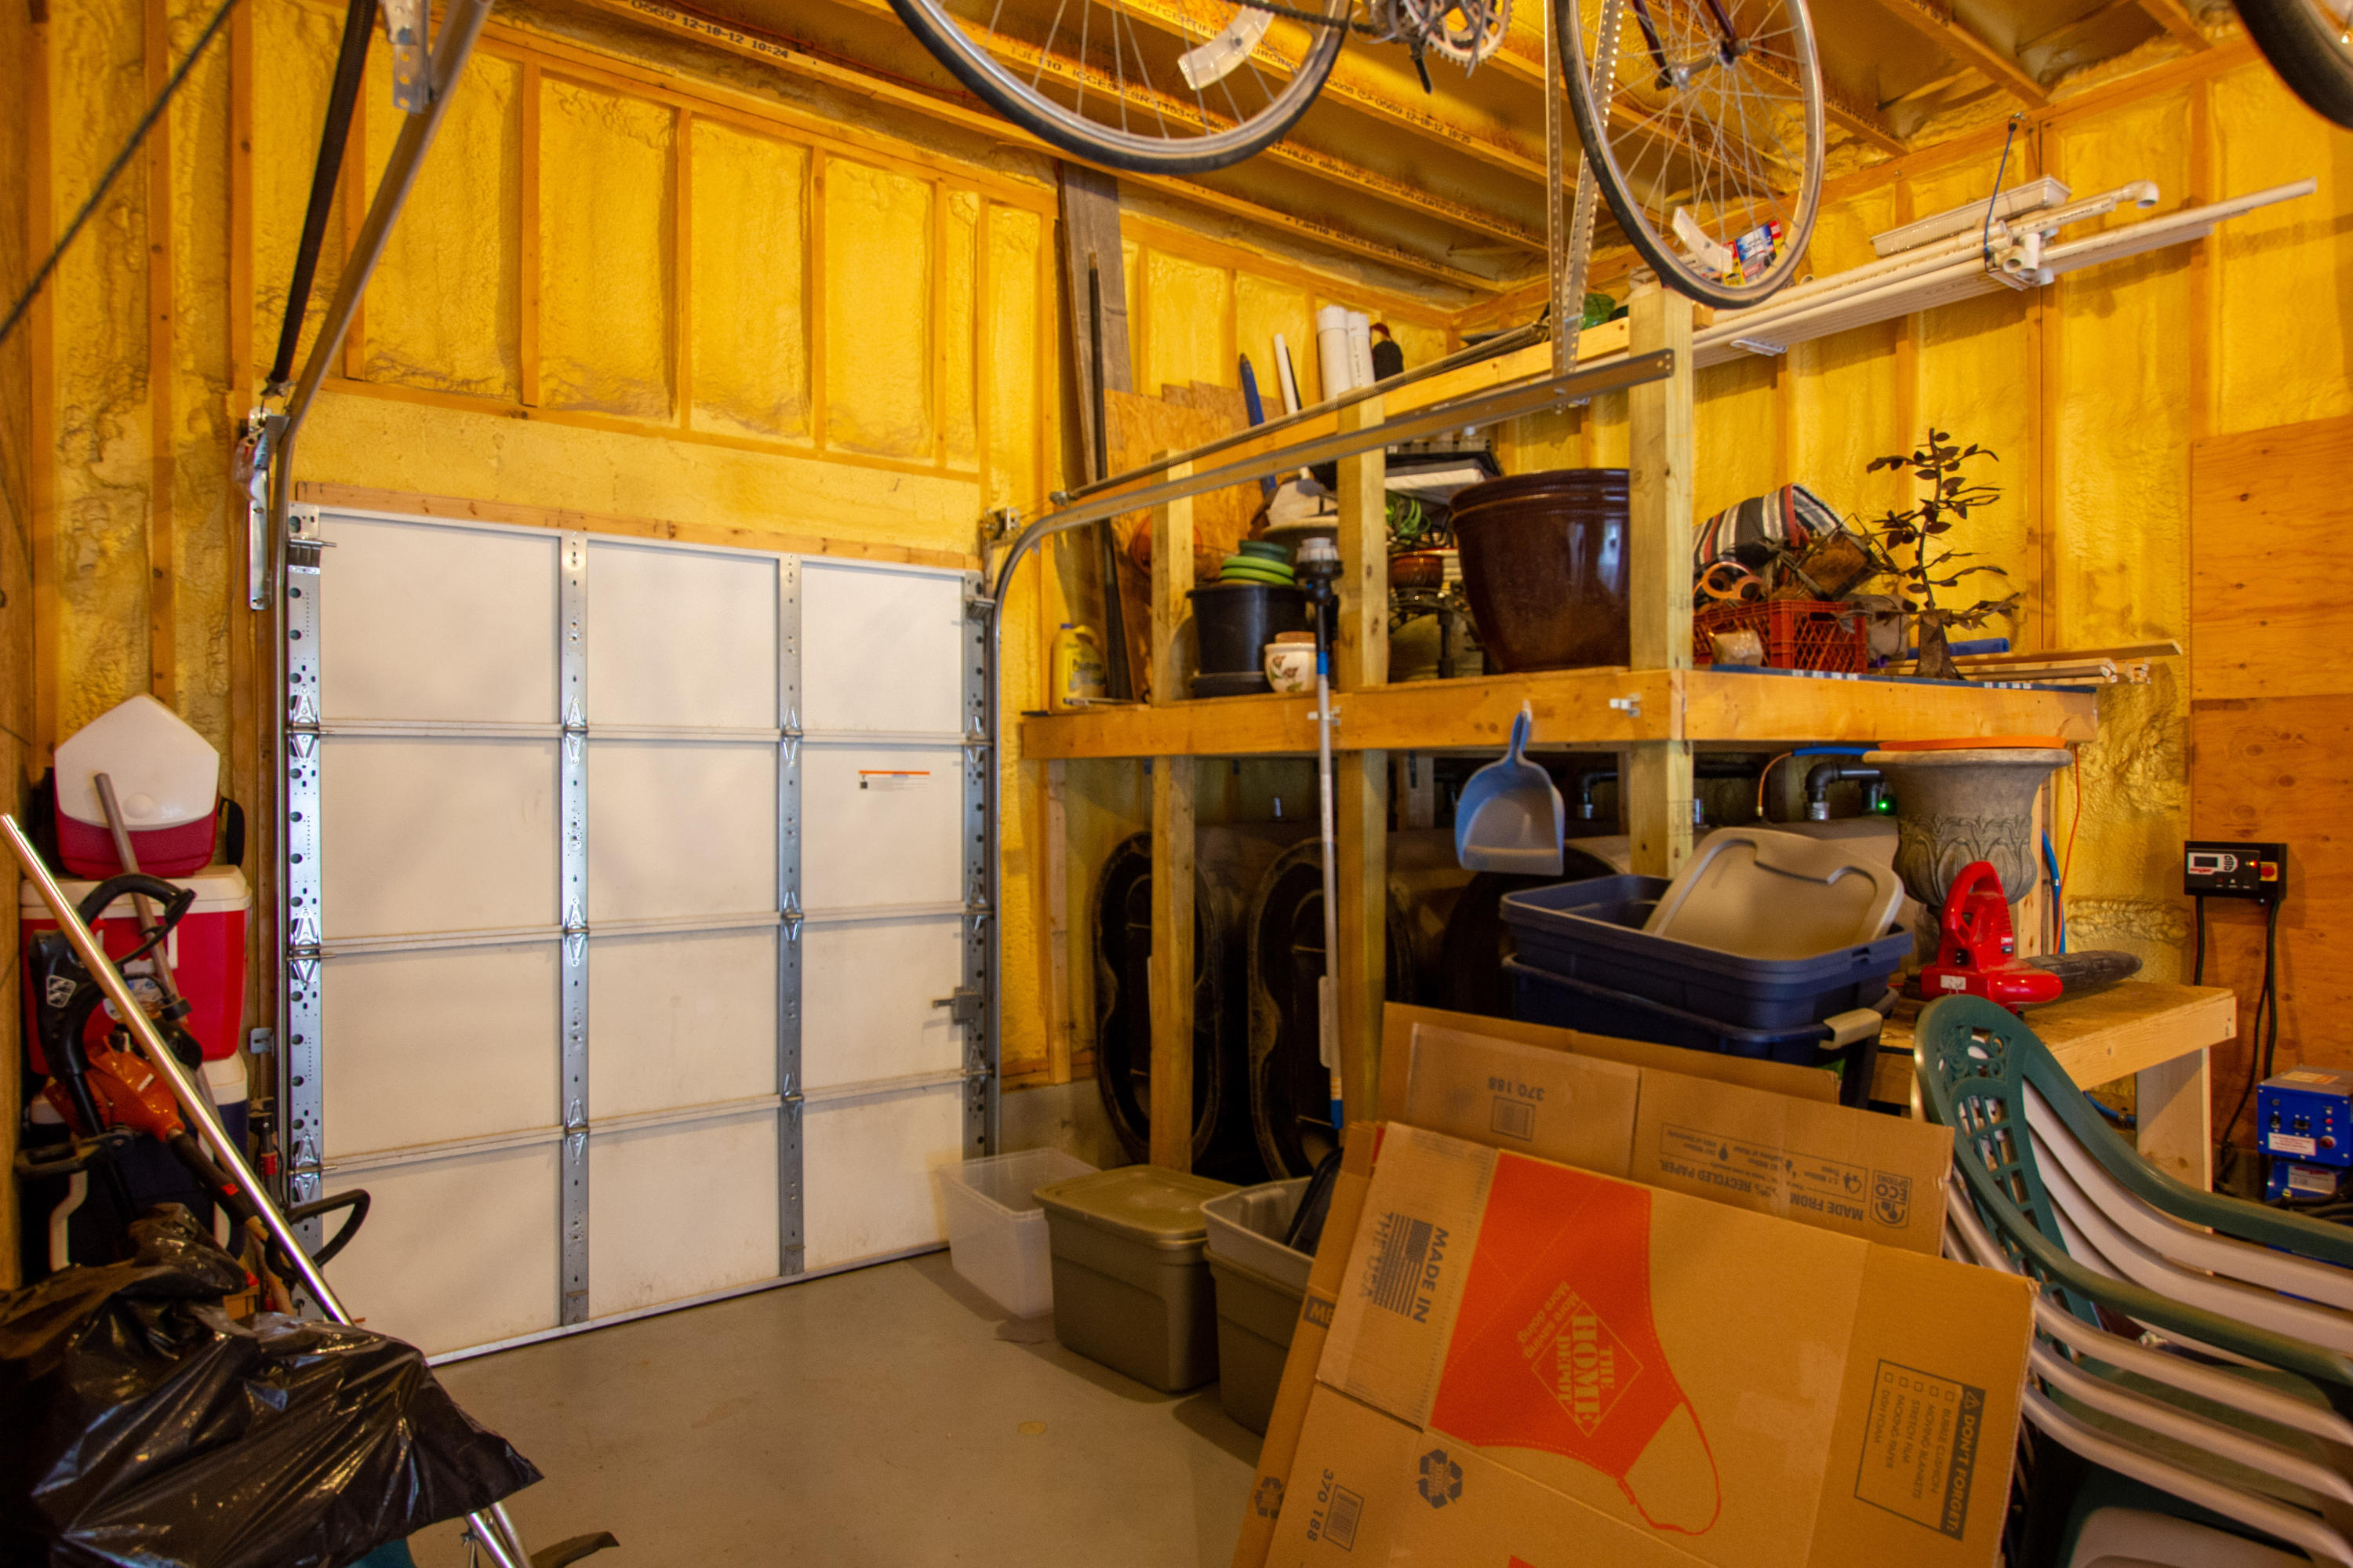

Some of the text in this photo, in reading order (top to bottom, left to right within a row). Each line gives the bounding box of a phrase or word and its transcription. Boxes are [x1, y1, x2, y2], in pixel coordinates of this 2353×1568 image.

[751, 40, 788, 58] 10:24
[1489, 1076, 1545, 1101] 370 188
[1698, 1168, 1751, 1194] RECYCLED
[1789, 1191, 1824, 1213] FROM
[1875, 1182, 1908, 1202] ECO
[1827, 1201, 1864, 1221] MADE
[1358, 1211, 1394, 1298] THE USA
[1413, 1227, 1449, 1324] MADE IN
[1544, 1280, 1570, 1311] More
[1554, 1291, 1580, 1322] More
[1556, 1336, 1572, 1404] DEPOT
[1572, 1315, 1601, 1424] HOME
[1599, 1345, 1614, 1389] THE
[1874, 1414, 1886, 1443] FOAM
[1885, 1394, 1905, 1469] PACKING PAPER
[1906, 1399, 1920, 1441] STRETCH
[1958, 1415, 1976, 1466] DON'T
[1912, 1402, 1935, 1501] MOVING BLANKETS
[1931, 1444, 1945, 1494] CUSHION
[1307, 1468, 1333, 1542] 370 188
